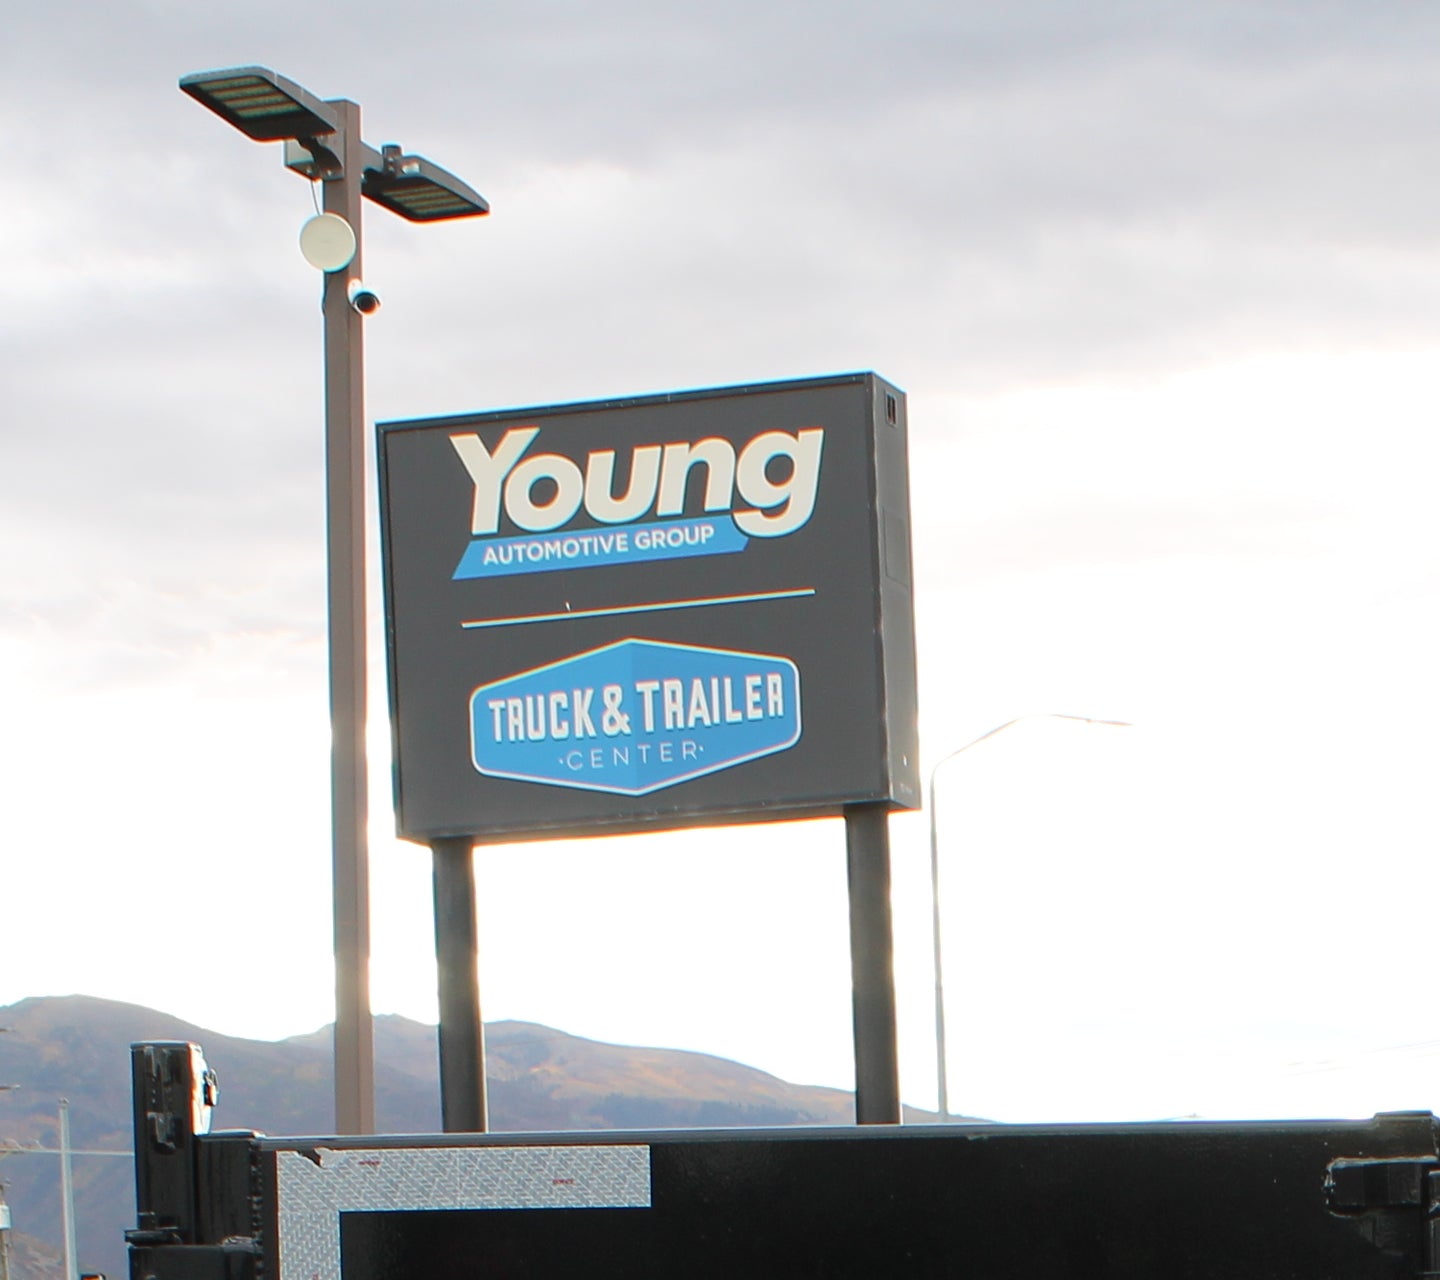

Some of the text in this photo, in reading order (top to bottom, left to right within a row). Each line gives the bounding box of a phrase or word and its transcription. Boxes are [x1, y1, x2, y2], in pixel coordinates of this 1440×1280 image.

[449, 426, 824, 537] Young
[483, 525, 715, 565] AUTOMOTIVE GROUP
[489, 673, 785, 742] TRUCK & TRAILER
[566, 742, 699, 771] CENTER
